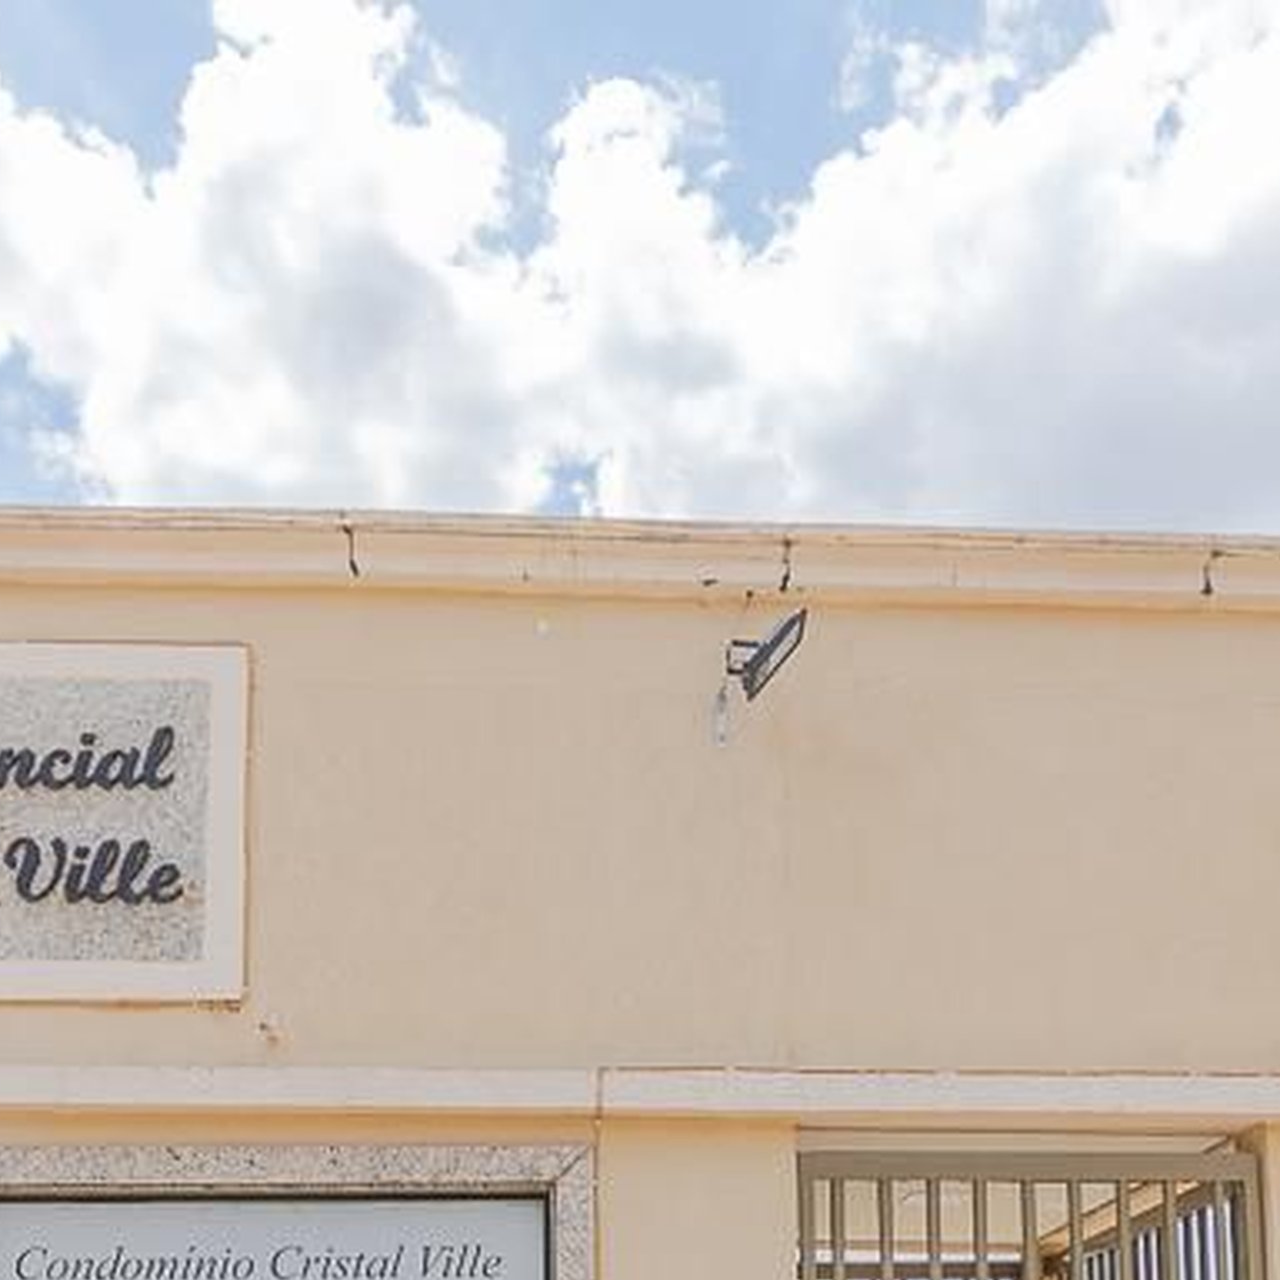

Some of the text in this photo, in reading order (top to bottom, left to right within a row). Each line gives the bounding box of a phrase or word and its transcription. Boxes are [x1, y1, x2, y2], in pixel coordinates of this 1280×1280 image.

[4, 837, 184, 905] Ville
[270, 1244, 404, 1280] Cristal
[418, 1243, 503, 1280] Ville
